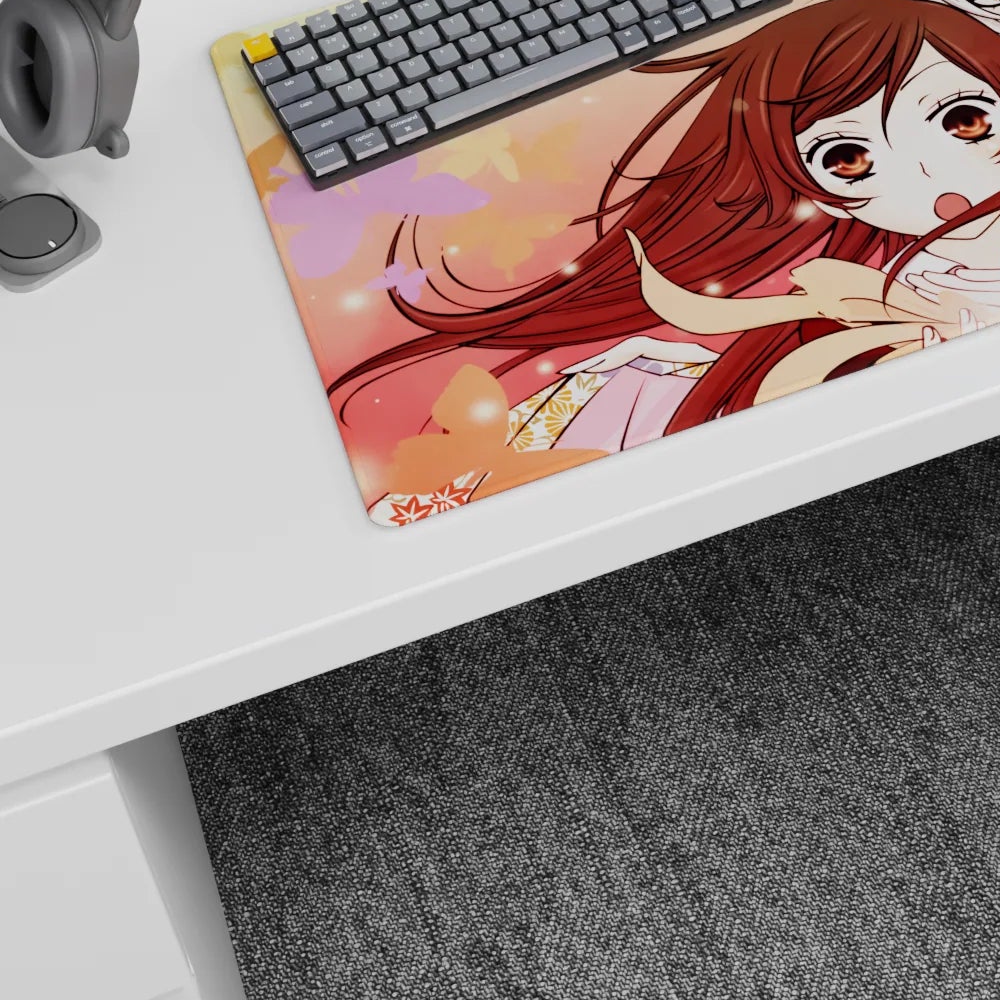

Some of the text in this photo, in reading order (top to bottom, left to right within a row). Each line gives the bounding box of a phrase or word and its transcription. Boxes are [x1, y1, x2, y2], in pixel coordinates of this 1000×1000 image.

[389, 113, 419, 129] command
[354, 131, 375, 143] option
[313, 146, 335, 159] control
